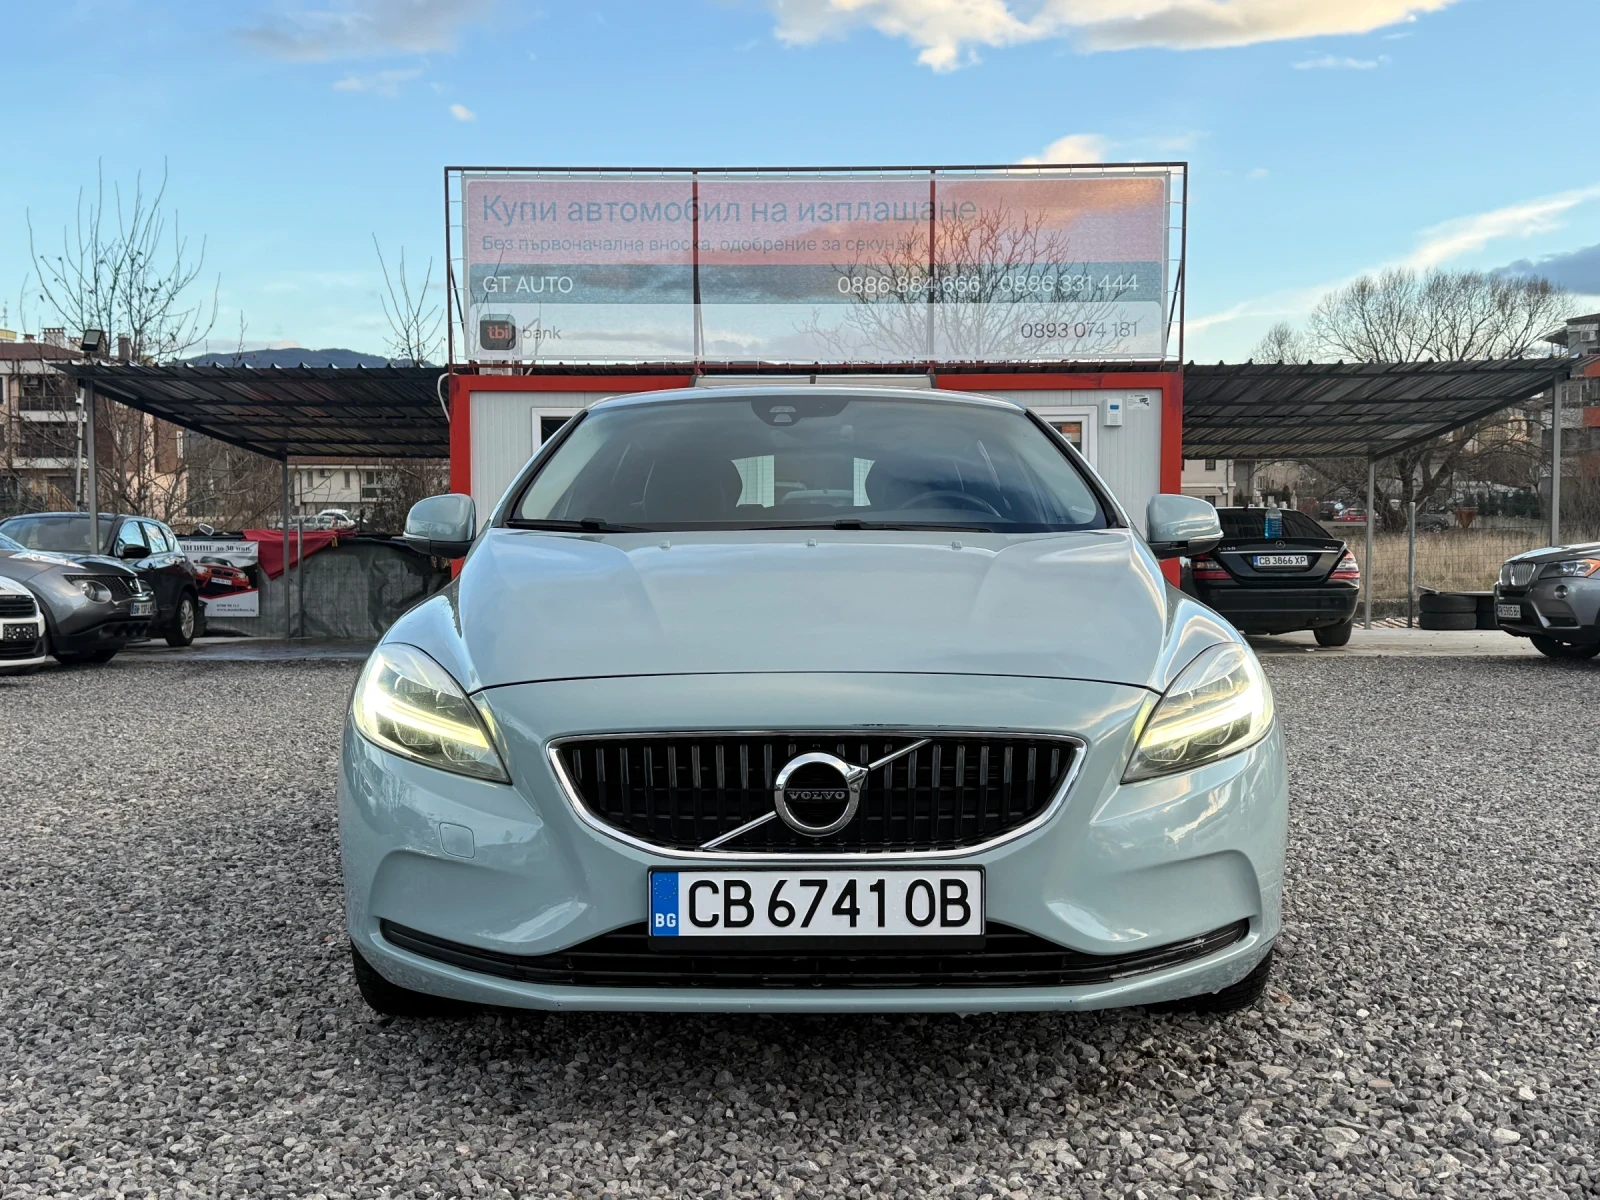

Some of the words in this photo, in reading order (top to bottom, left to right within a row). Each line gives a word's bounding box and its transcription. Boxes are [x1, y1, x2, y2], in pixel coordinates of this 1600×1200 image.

[483, 194, 557, 228] Купи
[567, 196, 741, 223] автомобил
[751, 201, 788, 223] на
[798, 198, 977, 227] изплащане
[482, 235, 514, 252] Без
[518, 238, 645, 254] първоначална
[650, 239, 715, 255] вноска,
[720, 235, 817, 256] одобрение
[821, 239, 841, 252] за
[845, 238, 918, 255] секунди
[482, 275, 512, 294] GT
[515, 275, 574, 294] AUTO
[837, 276, 890, 294] 0886
[896, 275, 937, 293] 884
[942, 275, 980, 293] 666
[999, 274, 1055, 293] 0886
[1059, 274, 1093, 293] 331
[1097, 273, 1140, 291] 444
[486, 325, 510, 340] tbi
[522, 325, 563, 340] bank
[1021, 322, 1069, 339] 0893
[1074, 322, 1107, 339] 074
[1112, 321, 1138, 338] 181
[1259, 556, 1271, 565] CB
[1272, 556, 1294, 565] 3866
[1295, 556, 1306, 565] XP
[787, 790, 847, 801] VOLVO
[688, 879, 755, 928] CB
[767, 878, 887, 929] 6741
[904, 878, 972, 928] OB
[654, 912, 677, 928] BG
